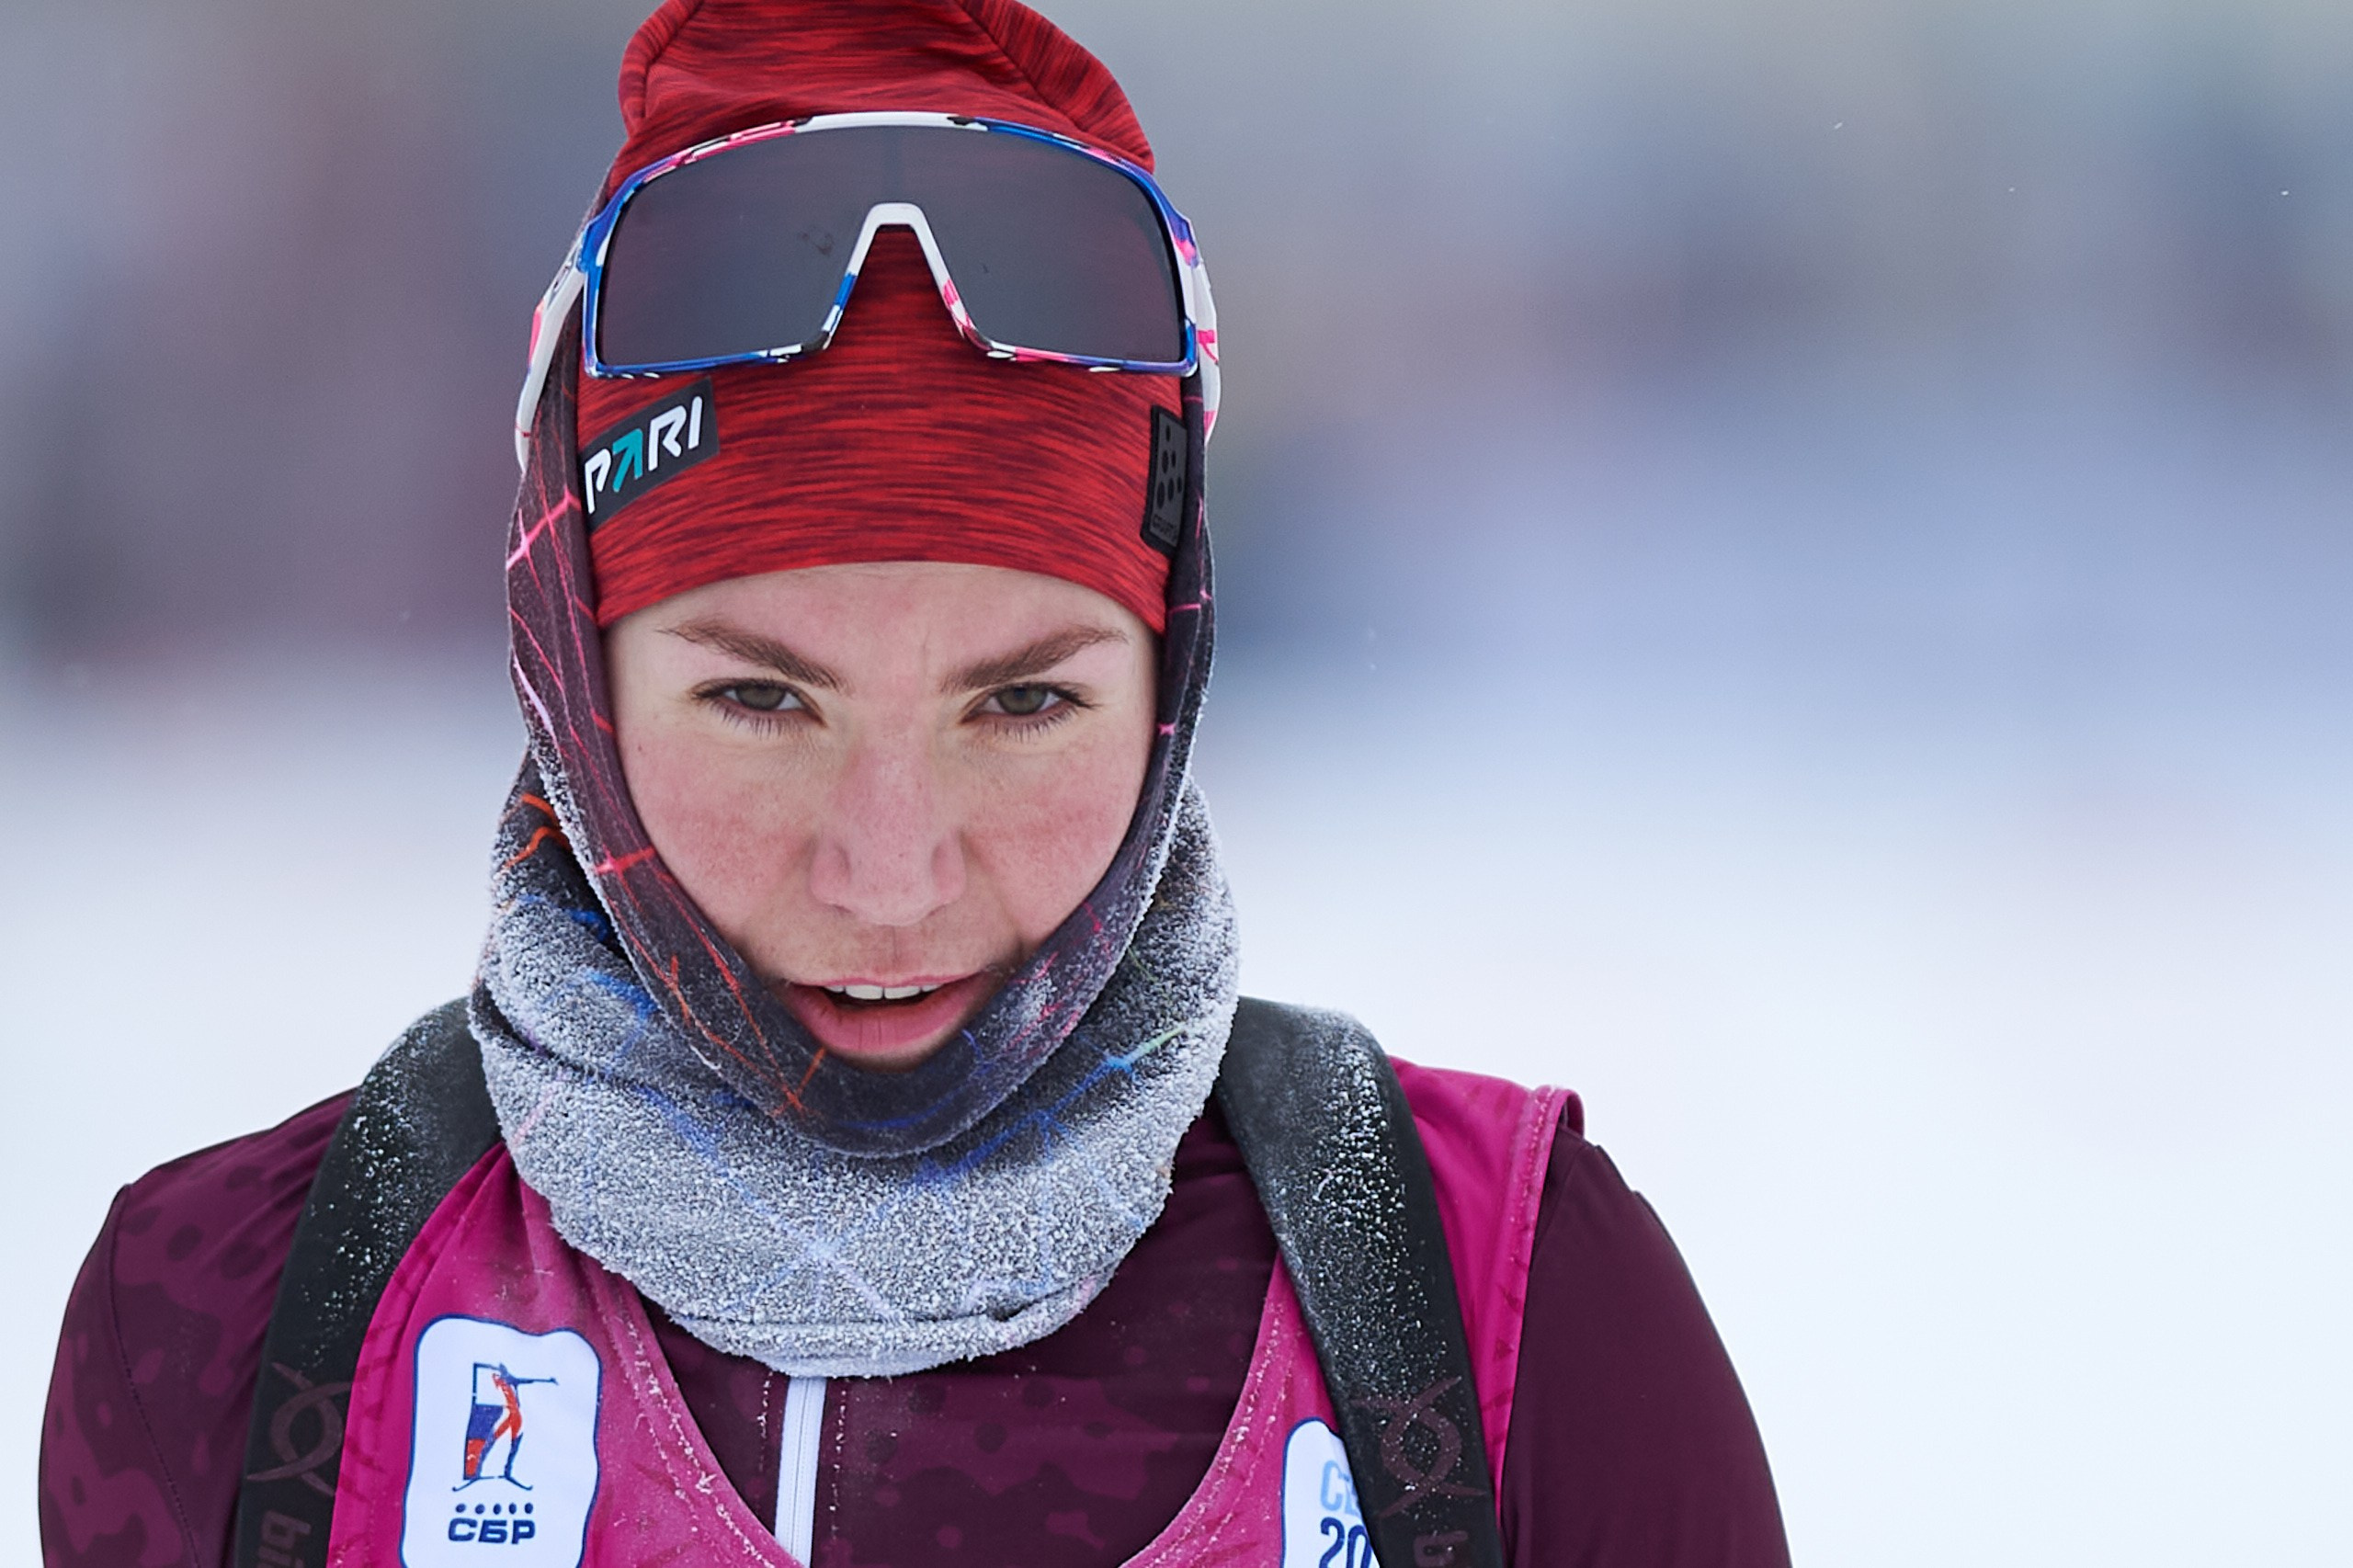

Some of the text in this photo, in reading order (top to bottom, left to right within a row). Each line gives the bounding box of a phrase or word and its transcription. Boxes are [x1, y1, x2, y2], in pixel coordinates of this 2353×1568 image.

[584, 395, 703, 515] PARI
[256, 1508, 312, 1568] bi
[447, 1517, 537, 1545] СБР
